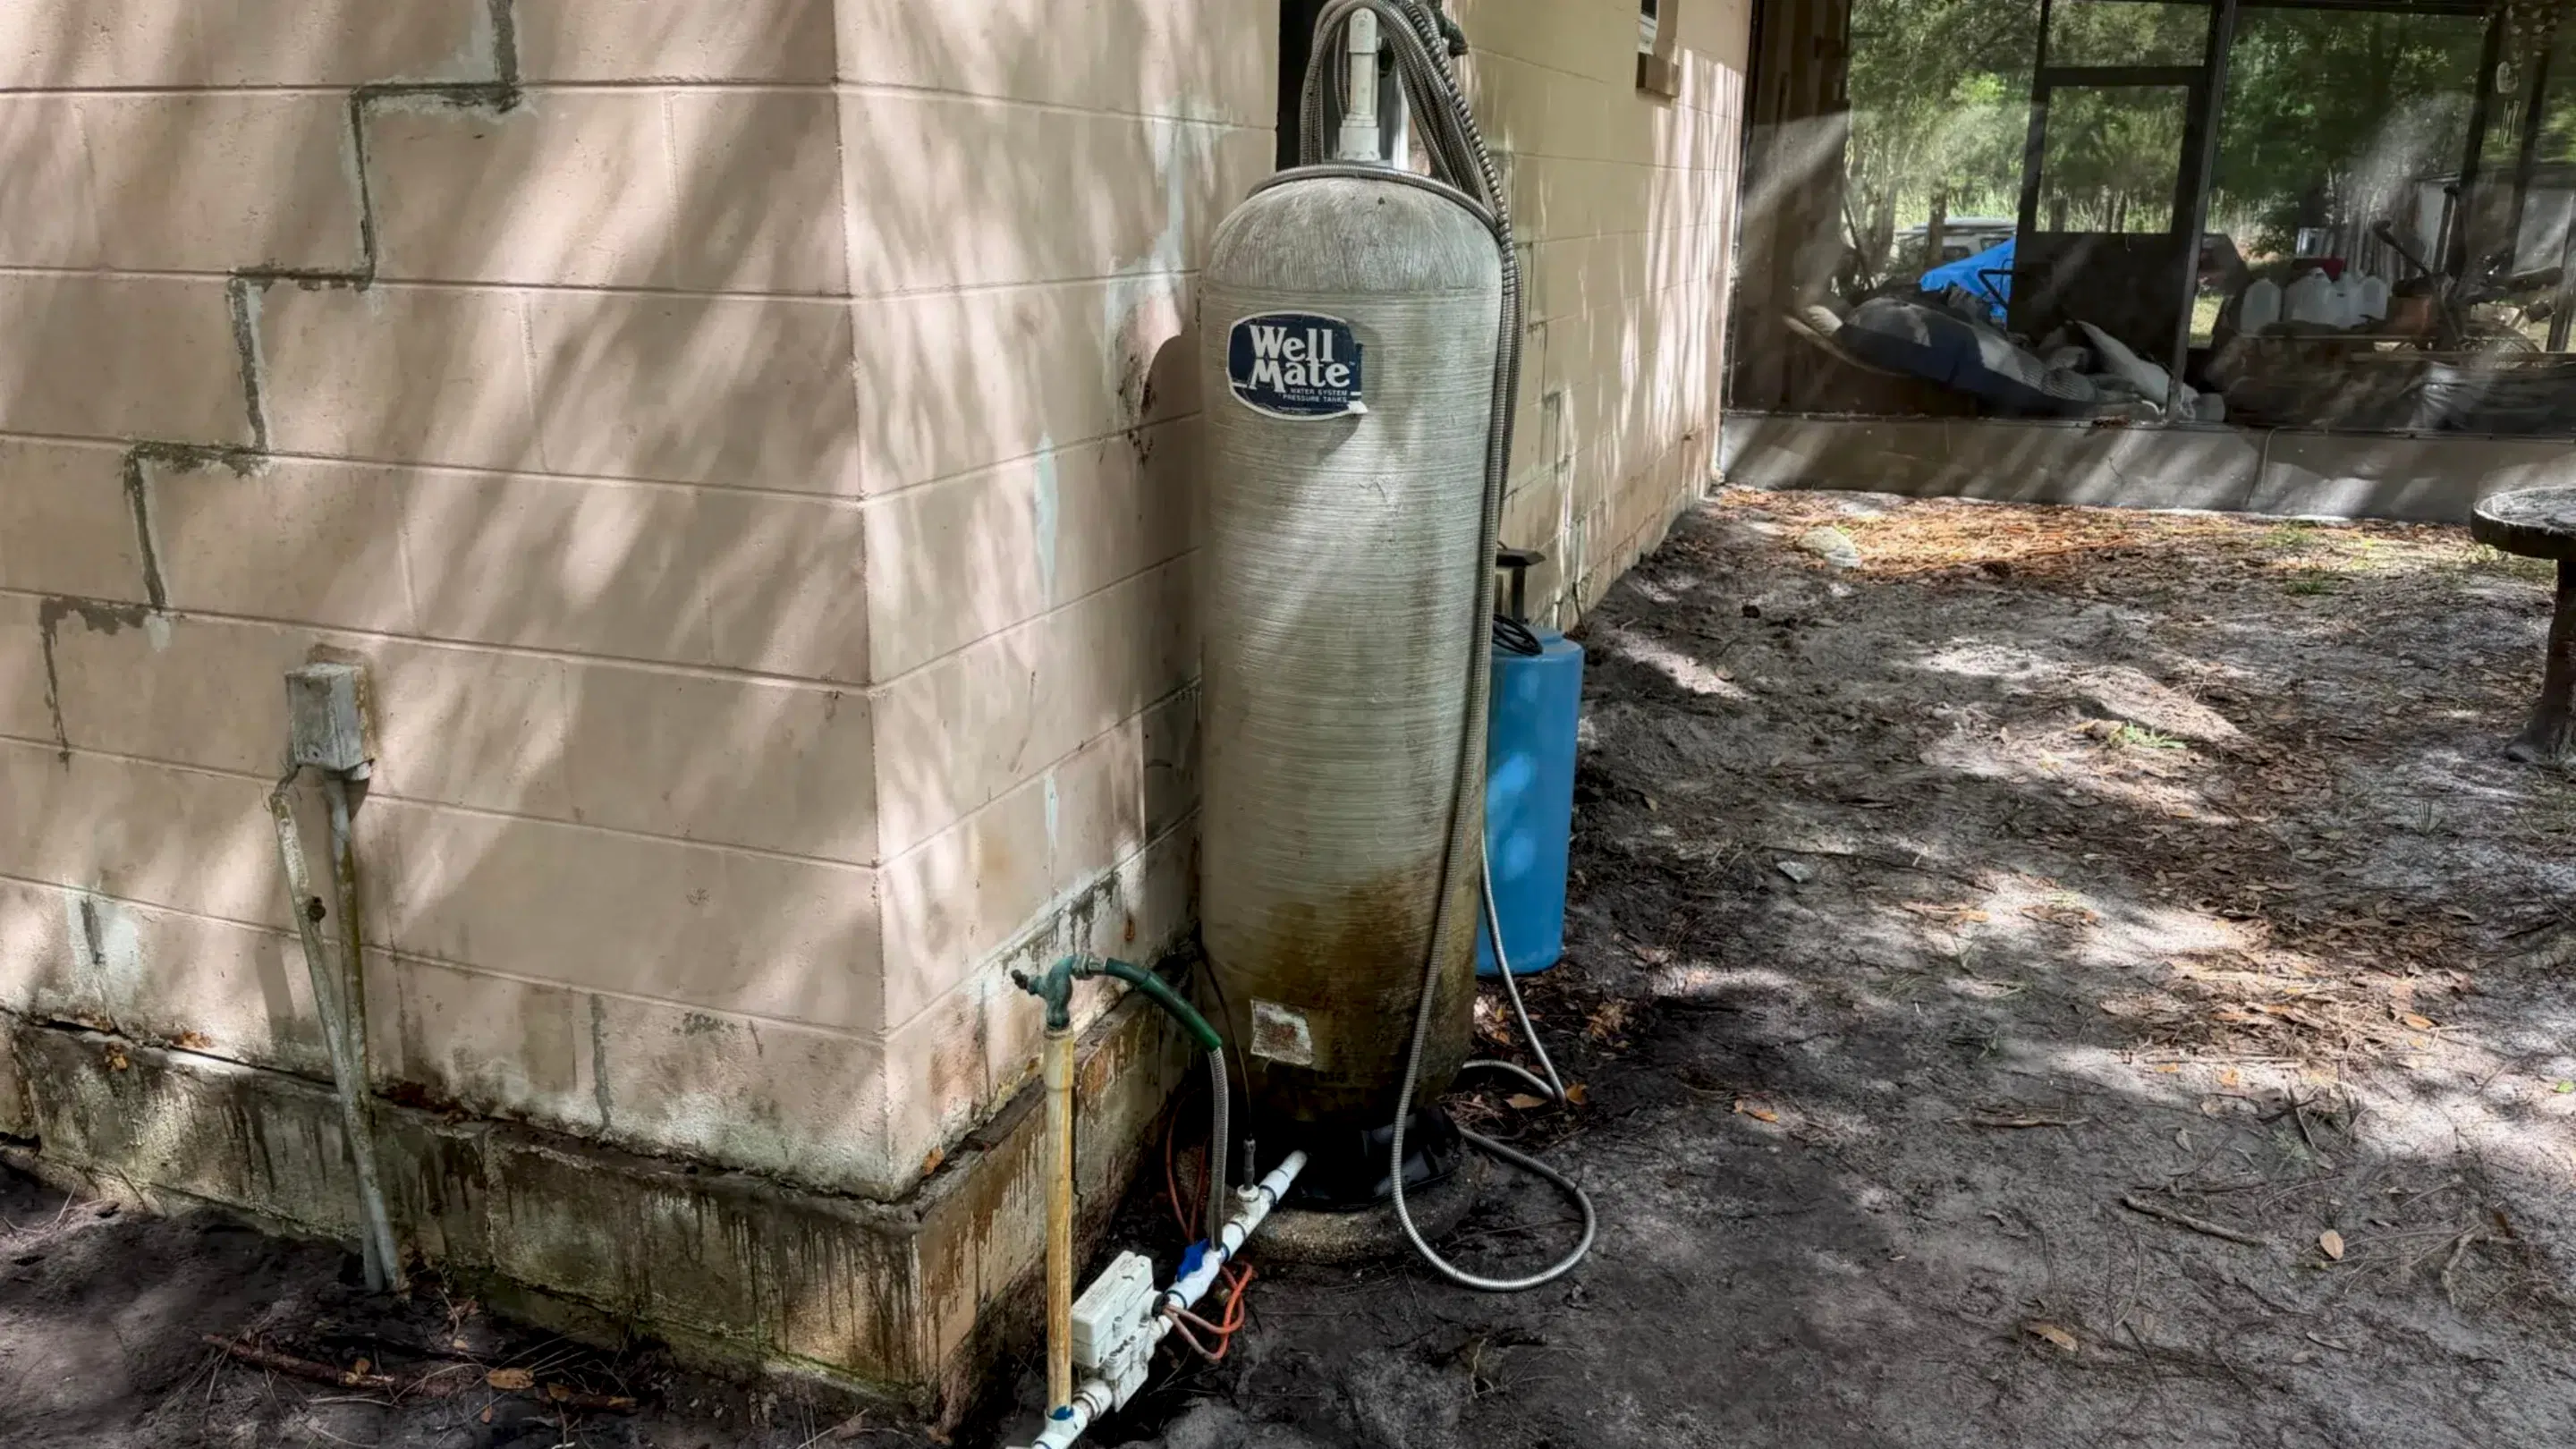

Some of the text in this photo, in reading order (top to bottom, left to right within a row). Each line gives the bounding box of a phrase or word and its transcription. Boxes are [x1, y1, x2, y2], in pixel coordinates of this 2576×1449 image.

[1249, 325, 1335, 362] Well
[1249, 358, 1350, 393] Mate
[1283, 394, 1319, 402] PRESSURE
[1290, 387, 1315, 395] WATER
